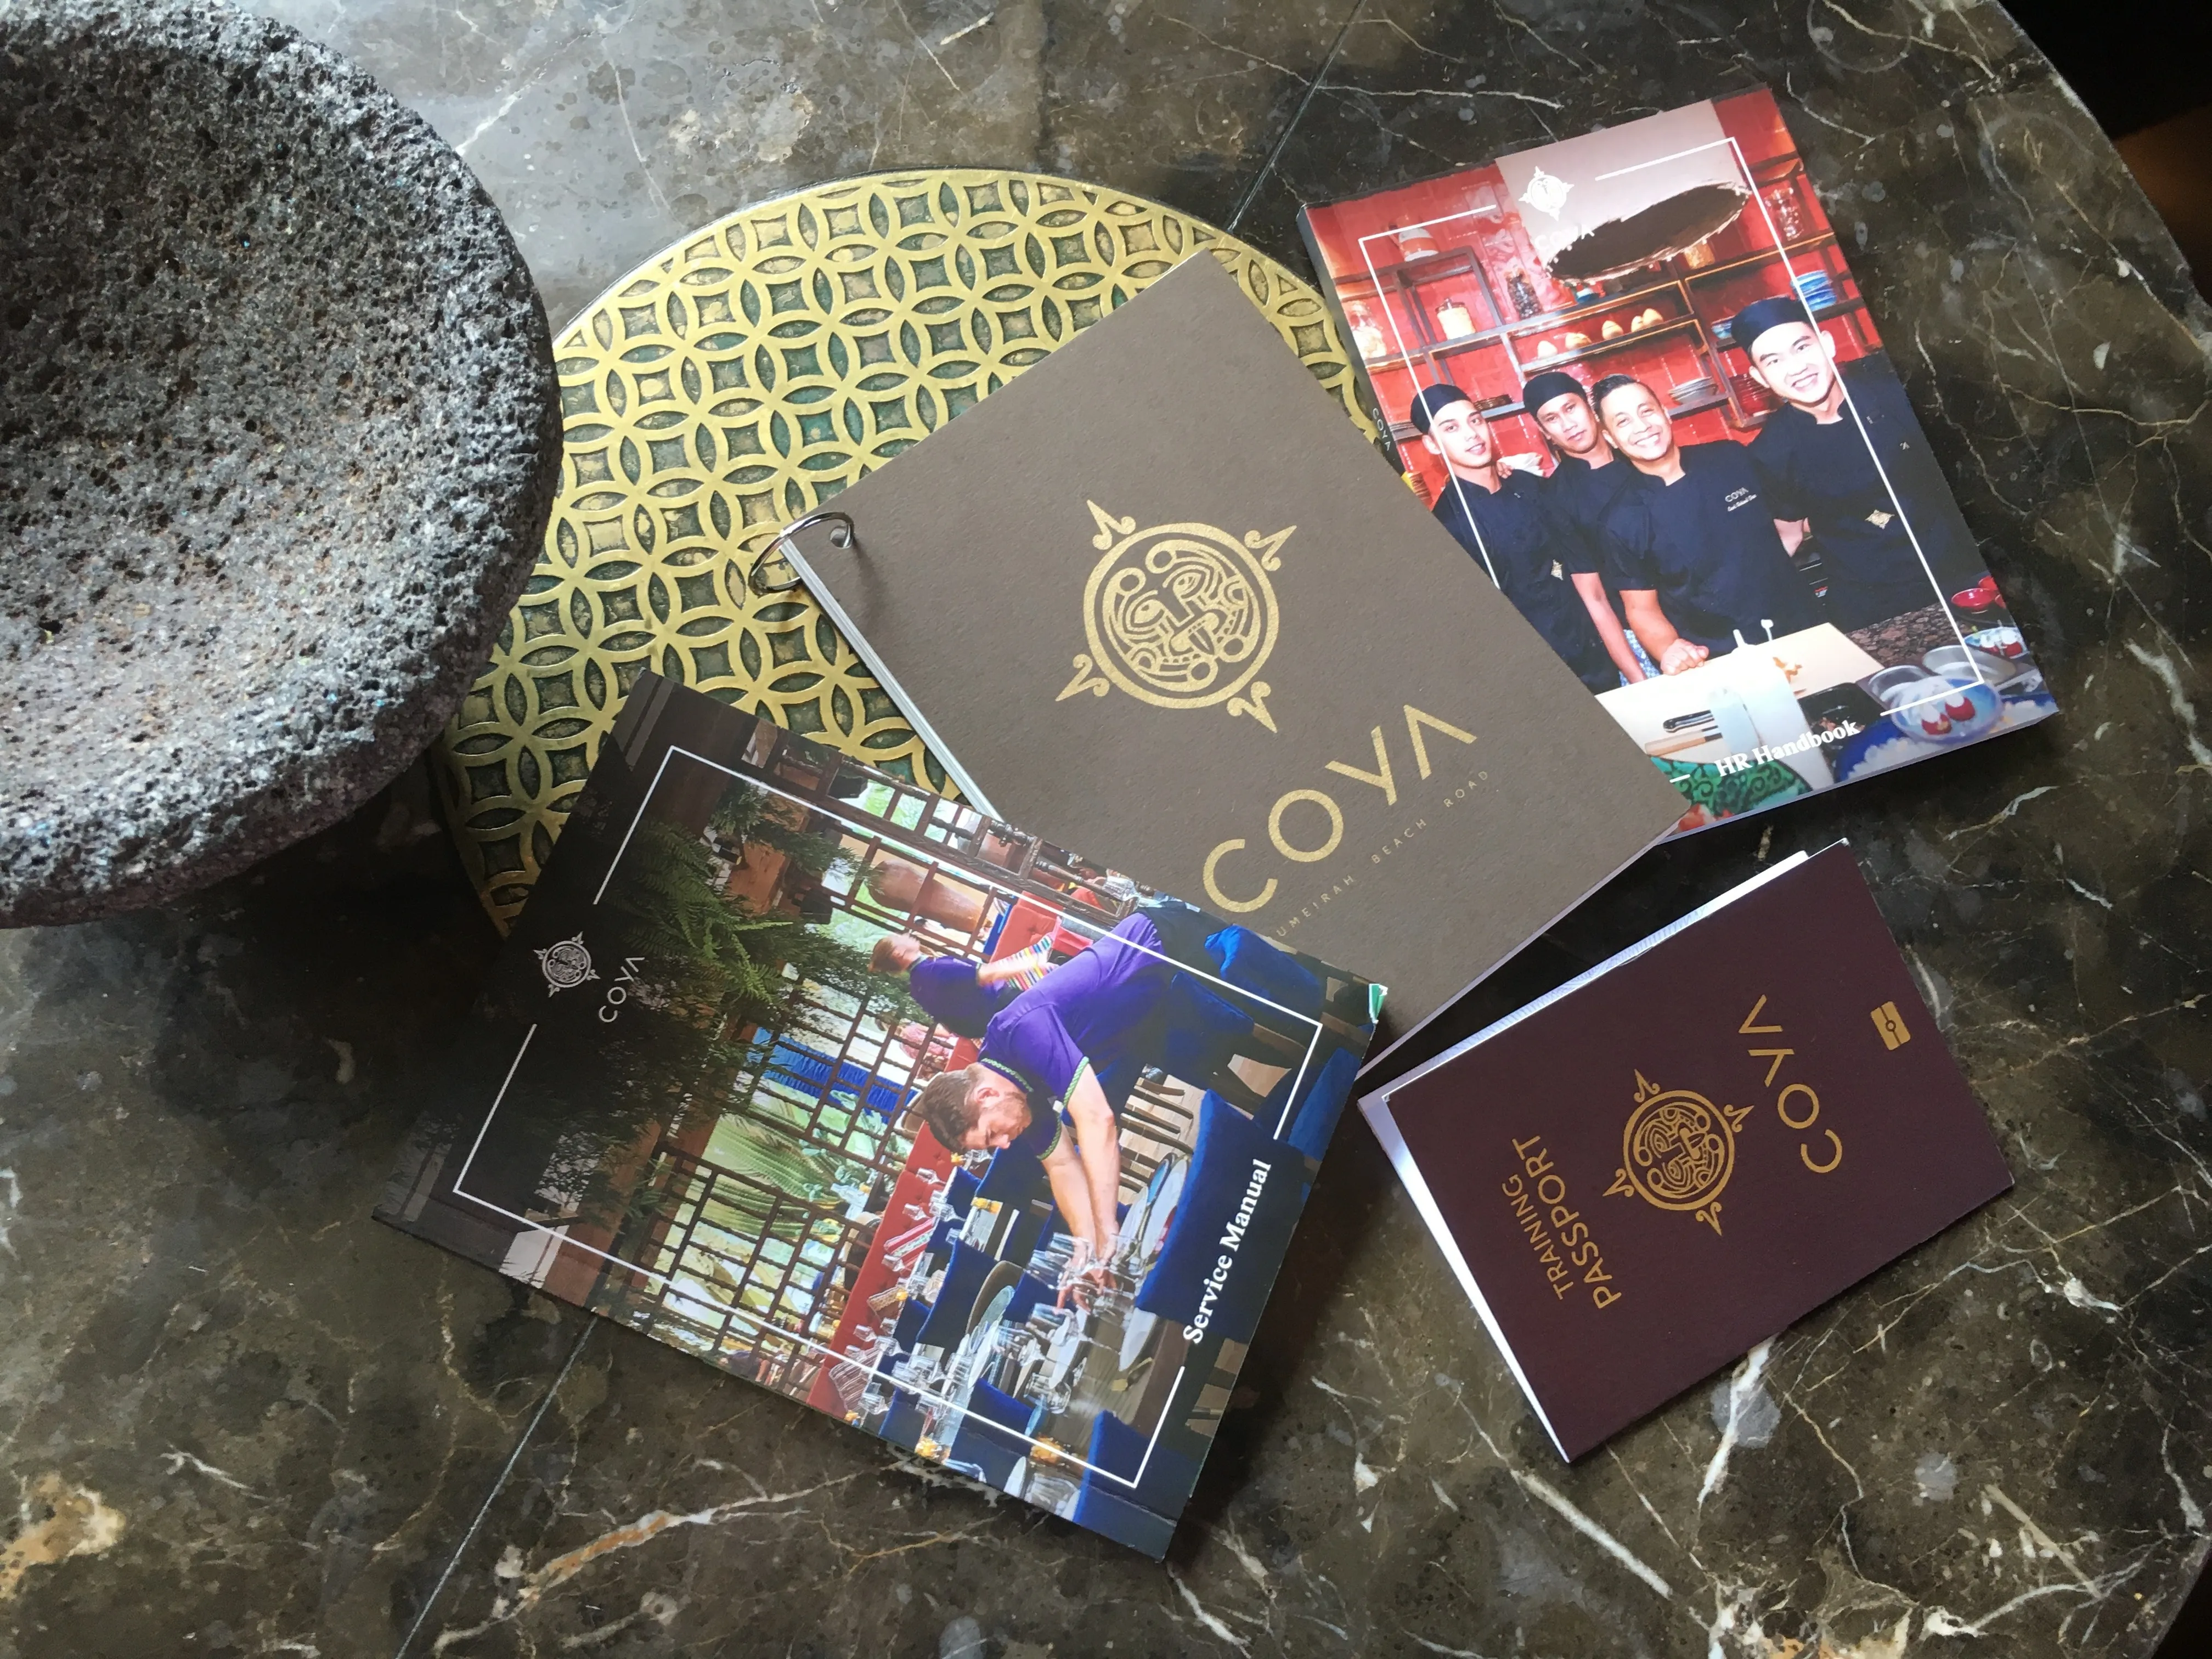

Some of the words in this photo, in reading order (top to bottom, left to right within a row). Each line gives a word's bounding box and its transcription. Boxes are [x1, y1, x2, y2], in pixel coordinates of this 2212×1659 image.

[1372, 408, 1391, 451] COYA
[1203, 704, 1477, 912] COYA
[1714, 753, 1753, 777] HR
[1751, 719, 1861, 765] Handbook
[1276, 875, 1354, 936] UMEIRAH
[1372, 819, 1426, 864] BEACH
[1443, 771, 1488, 808] ROAD
[599, 957, 645, 1023] COYA
[1739, 994, 1843, 1173] COYA
[1183, 1254, 1233, 1344] Service
[1220, 1158, 1272, 1252] Manual
[1502, 1175, 1573, 1300] TRAINING
[1511, 1135, 1621, 1309] PASSPORT
